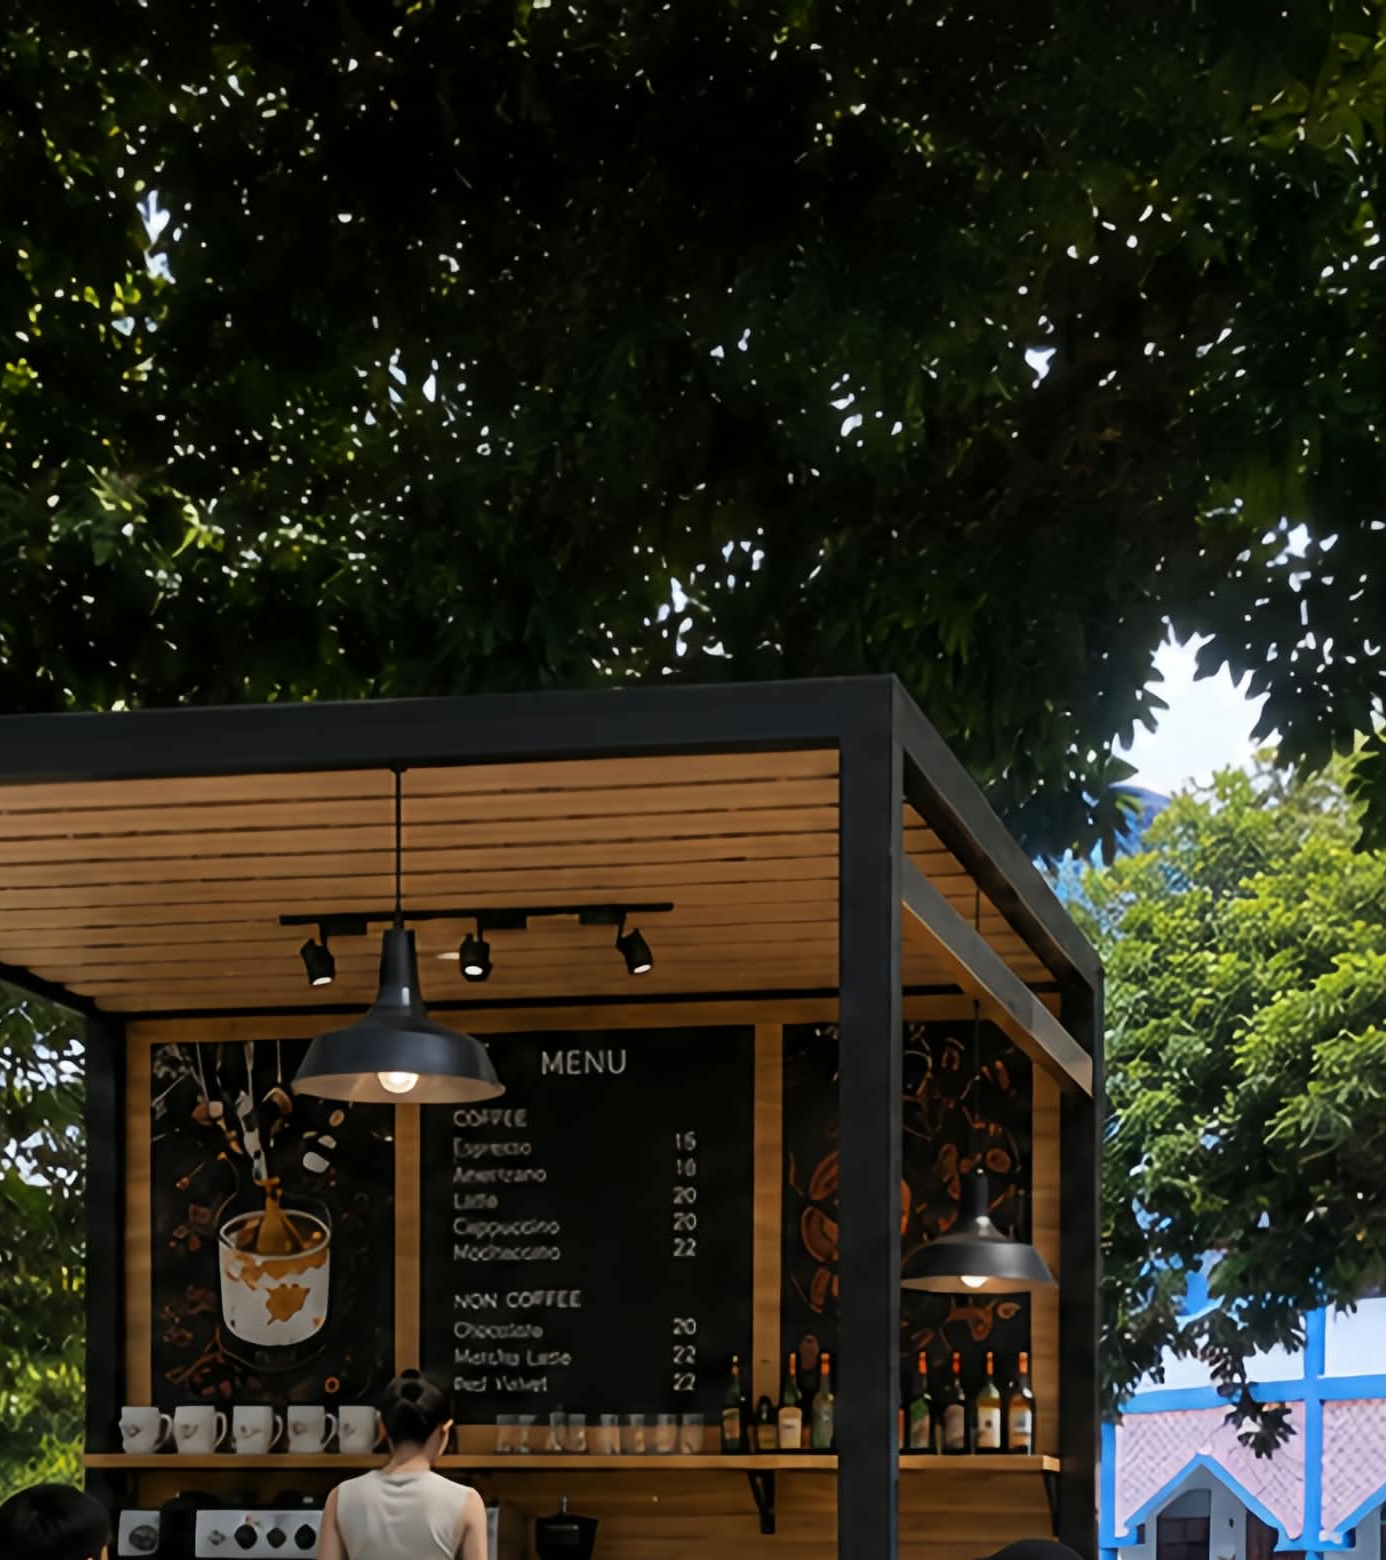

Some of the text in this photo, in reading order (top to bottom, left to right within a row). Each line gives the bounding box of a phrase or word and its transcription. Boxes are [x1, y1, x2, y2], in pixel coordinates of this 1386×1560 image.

[541, 1050, 627, 1076] MENU
[453, 1108, 527, 1127] COFFEE
[673, 1186, 697, 1205] 20
[673, 1212, 697, 1231] 20
[673, 1238, 697, 1257] 22
[454, 1290, 581, 1309] NON COFFEE
[673, 1318, 697, 1335] 20
[673, 1345, 697, 1364] 22
[673, 1373, 697, 1391] 22
